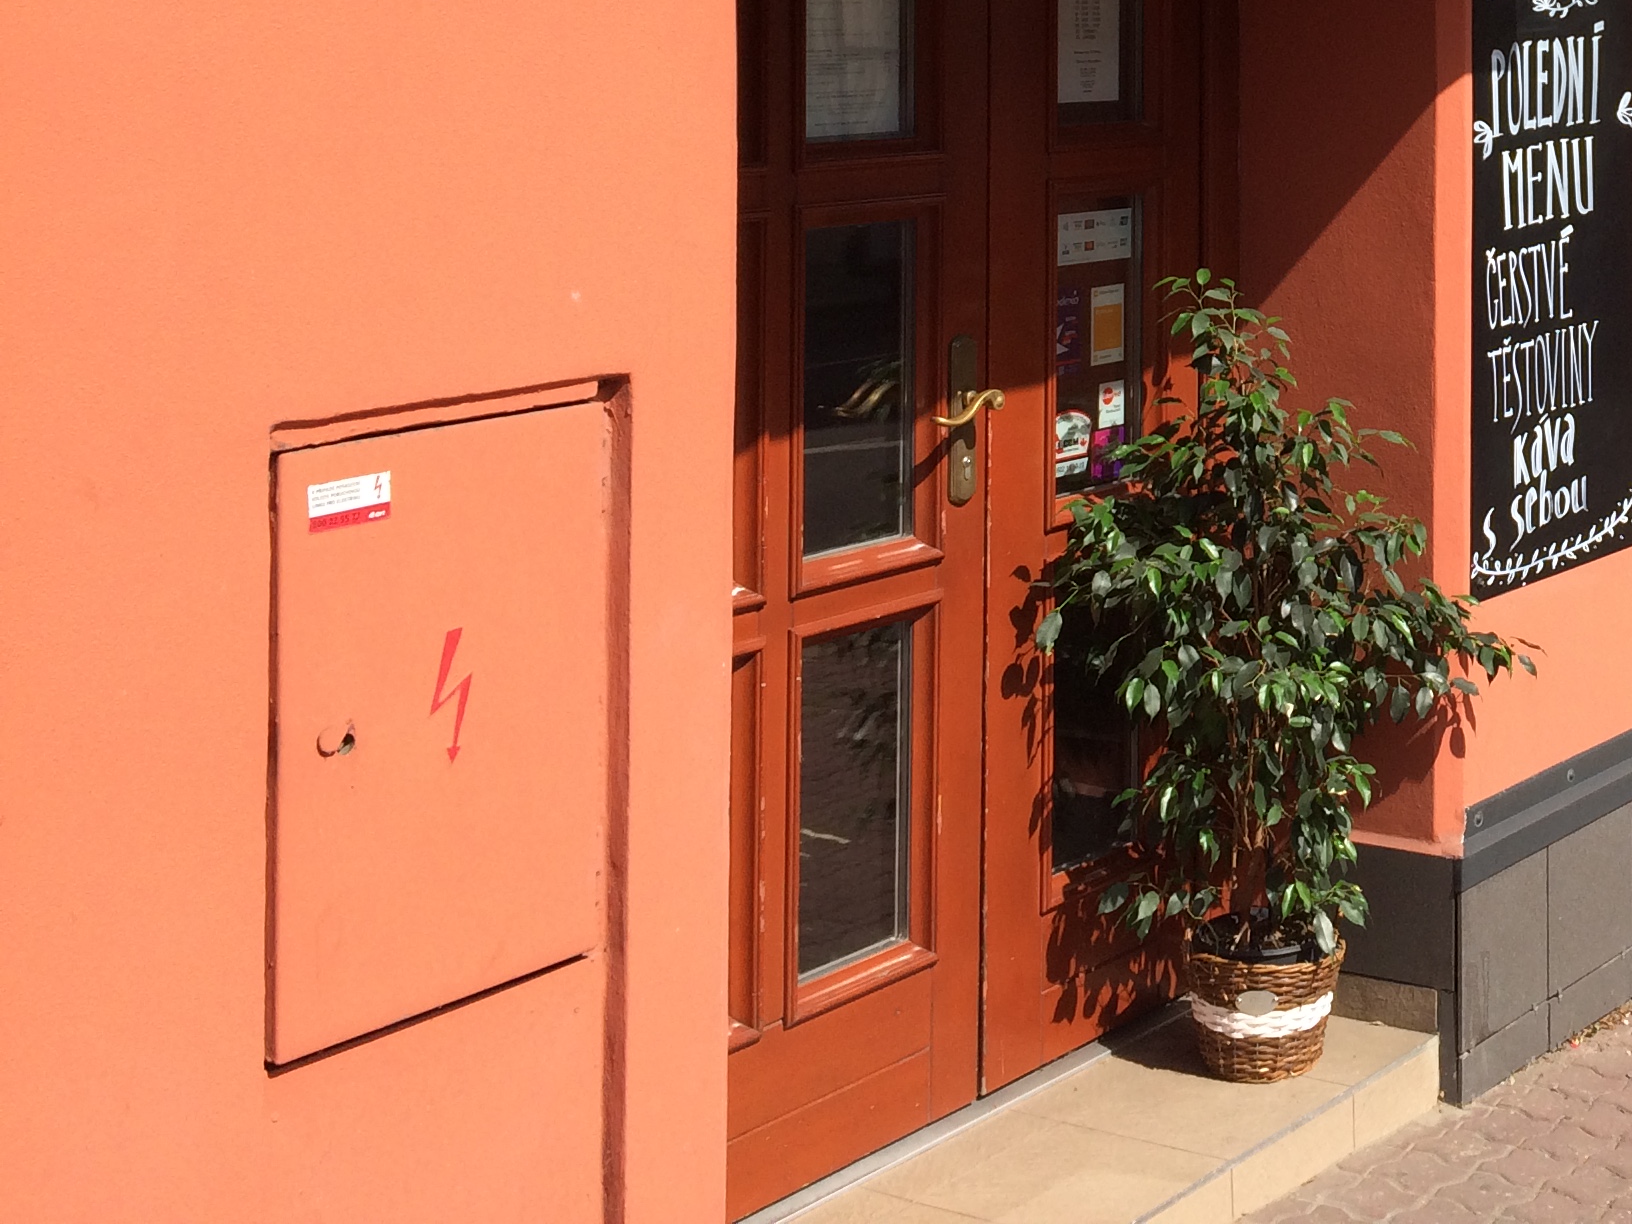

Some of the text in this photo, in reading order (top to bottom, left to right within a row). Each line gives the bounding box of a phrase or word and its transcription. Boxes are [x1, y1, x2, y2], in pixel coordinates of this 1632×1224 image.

[1490, 20, 1604, 137] POLEDNÍ
[1501, 136, 1594, 231] MENU
[1486, 225, 1574, 330] ČERSTVÉ
[1487, 320, 1599, 435] TĚSTOVINY
